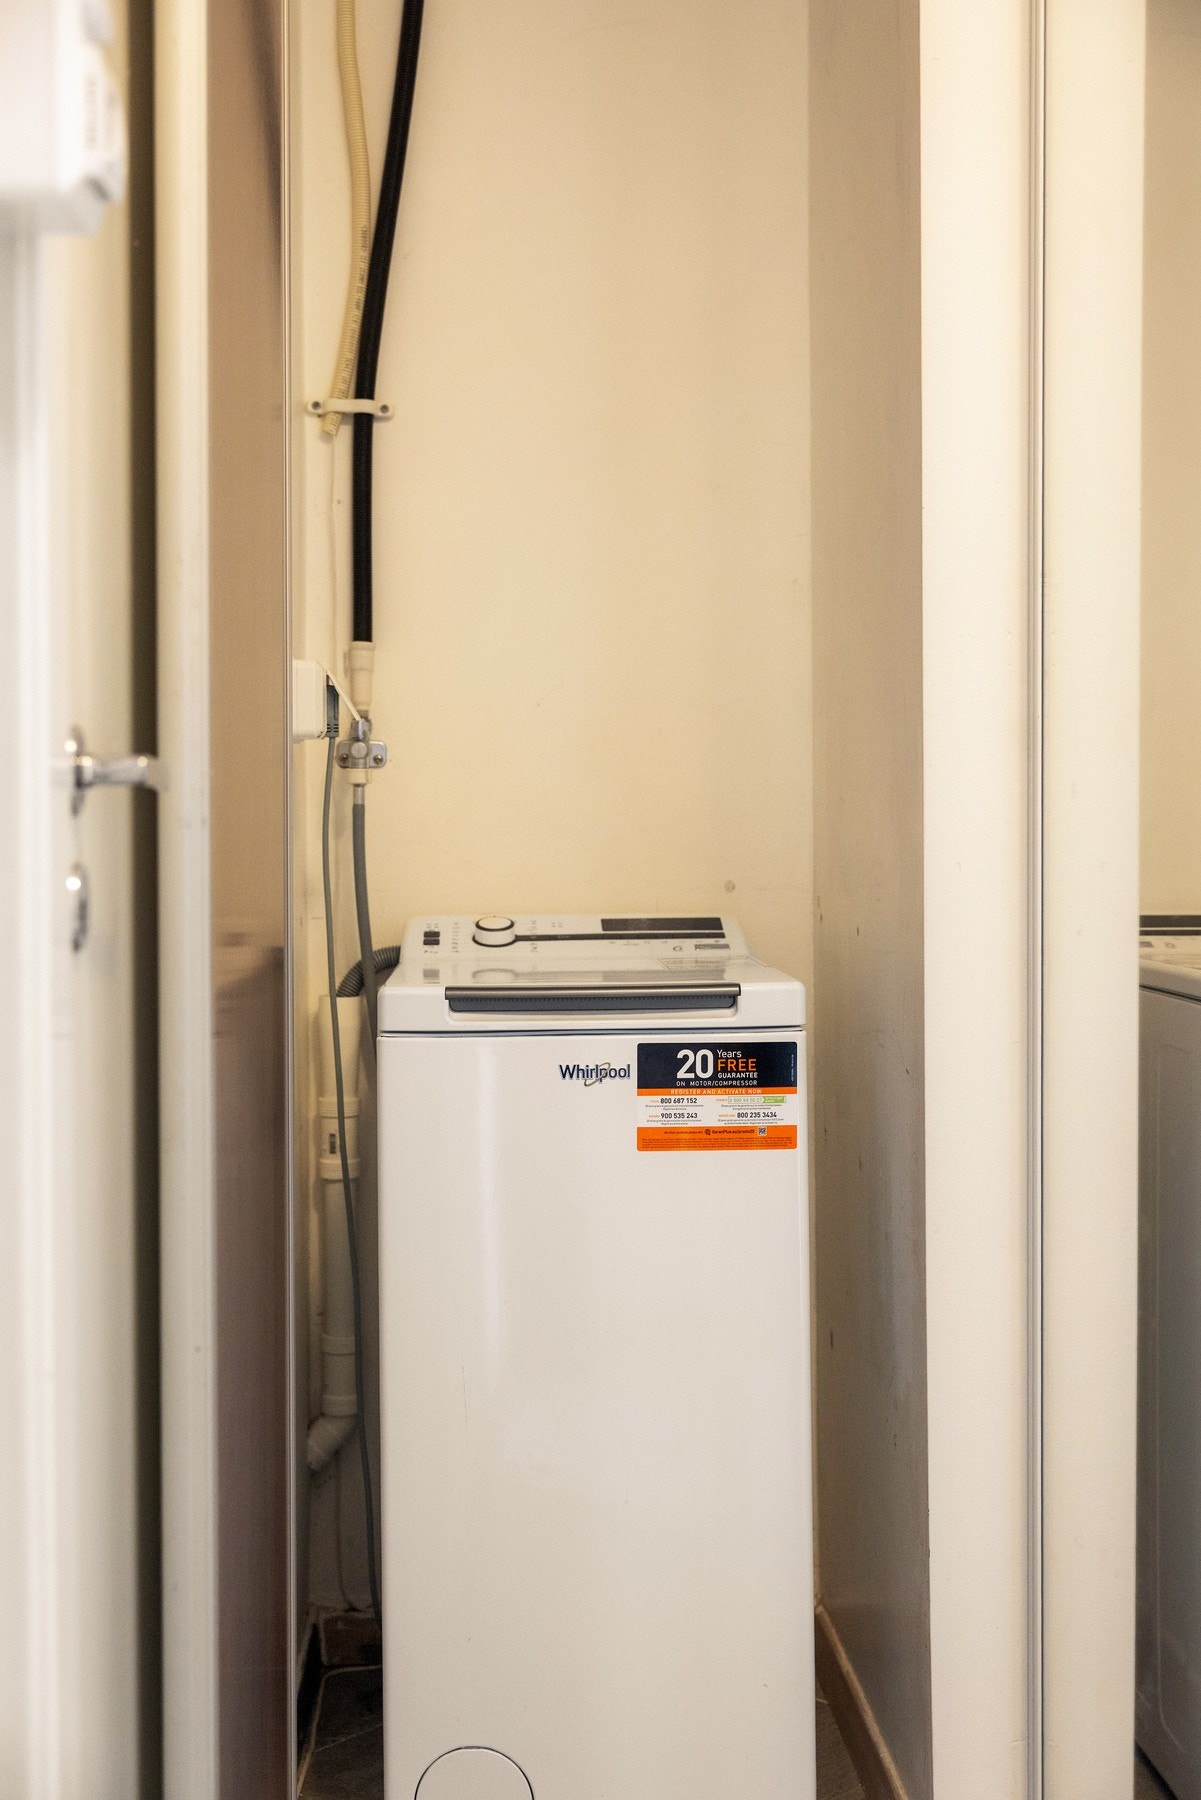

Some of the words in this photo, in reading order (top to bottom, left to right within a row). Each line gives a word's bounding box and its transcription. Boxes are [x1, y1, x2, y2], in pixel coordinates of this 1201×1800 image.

[716, 1049, 742, 1058] Years
[676, 1049, 714, 1079] 20
[717, 1058, 757, 1072] FREE
[559, 1063, 631, 1083] Whirlpool
